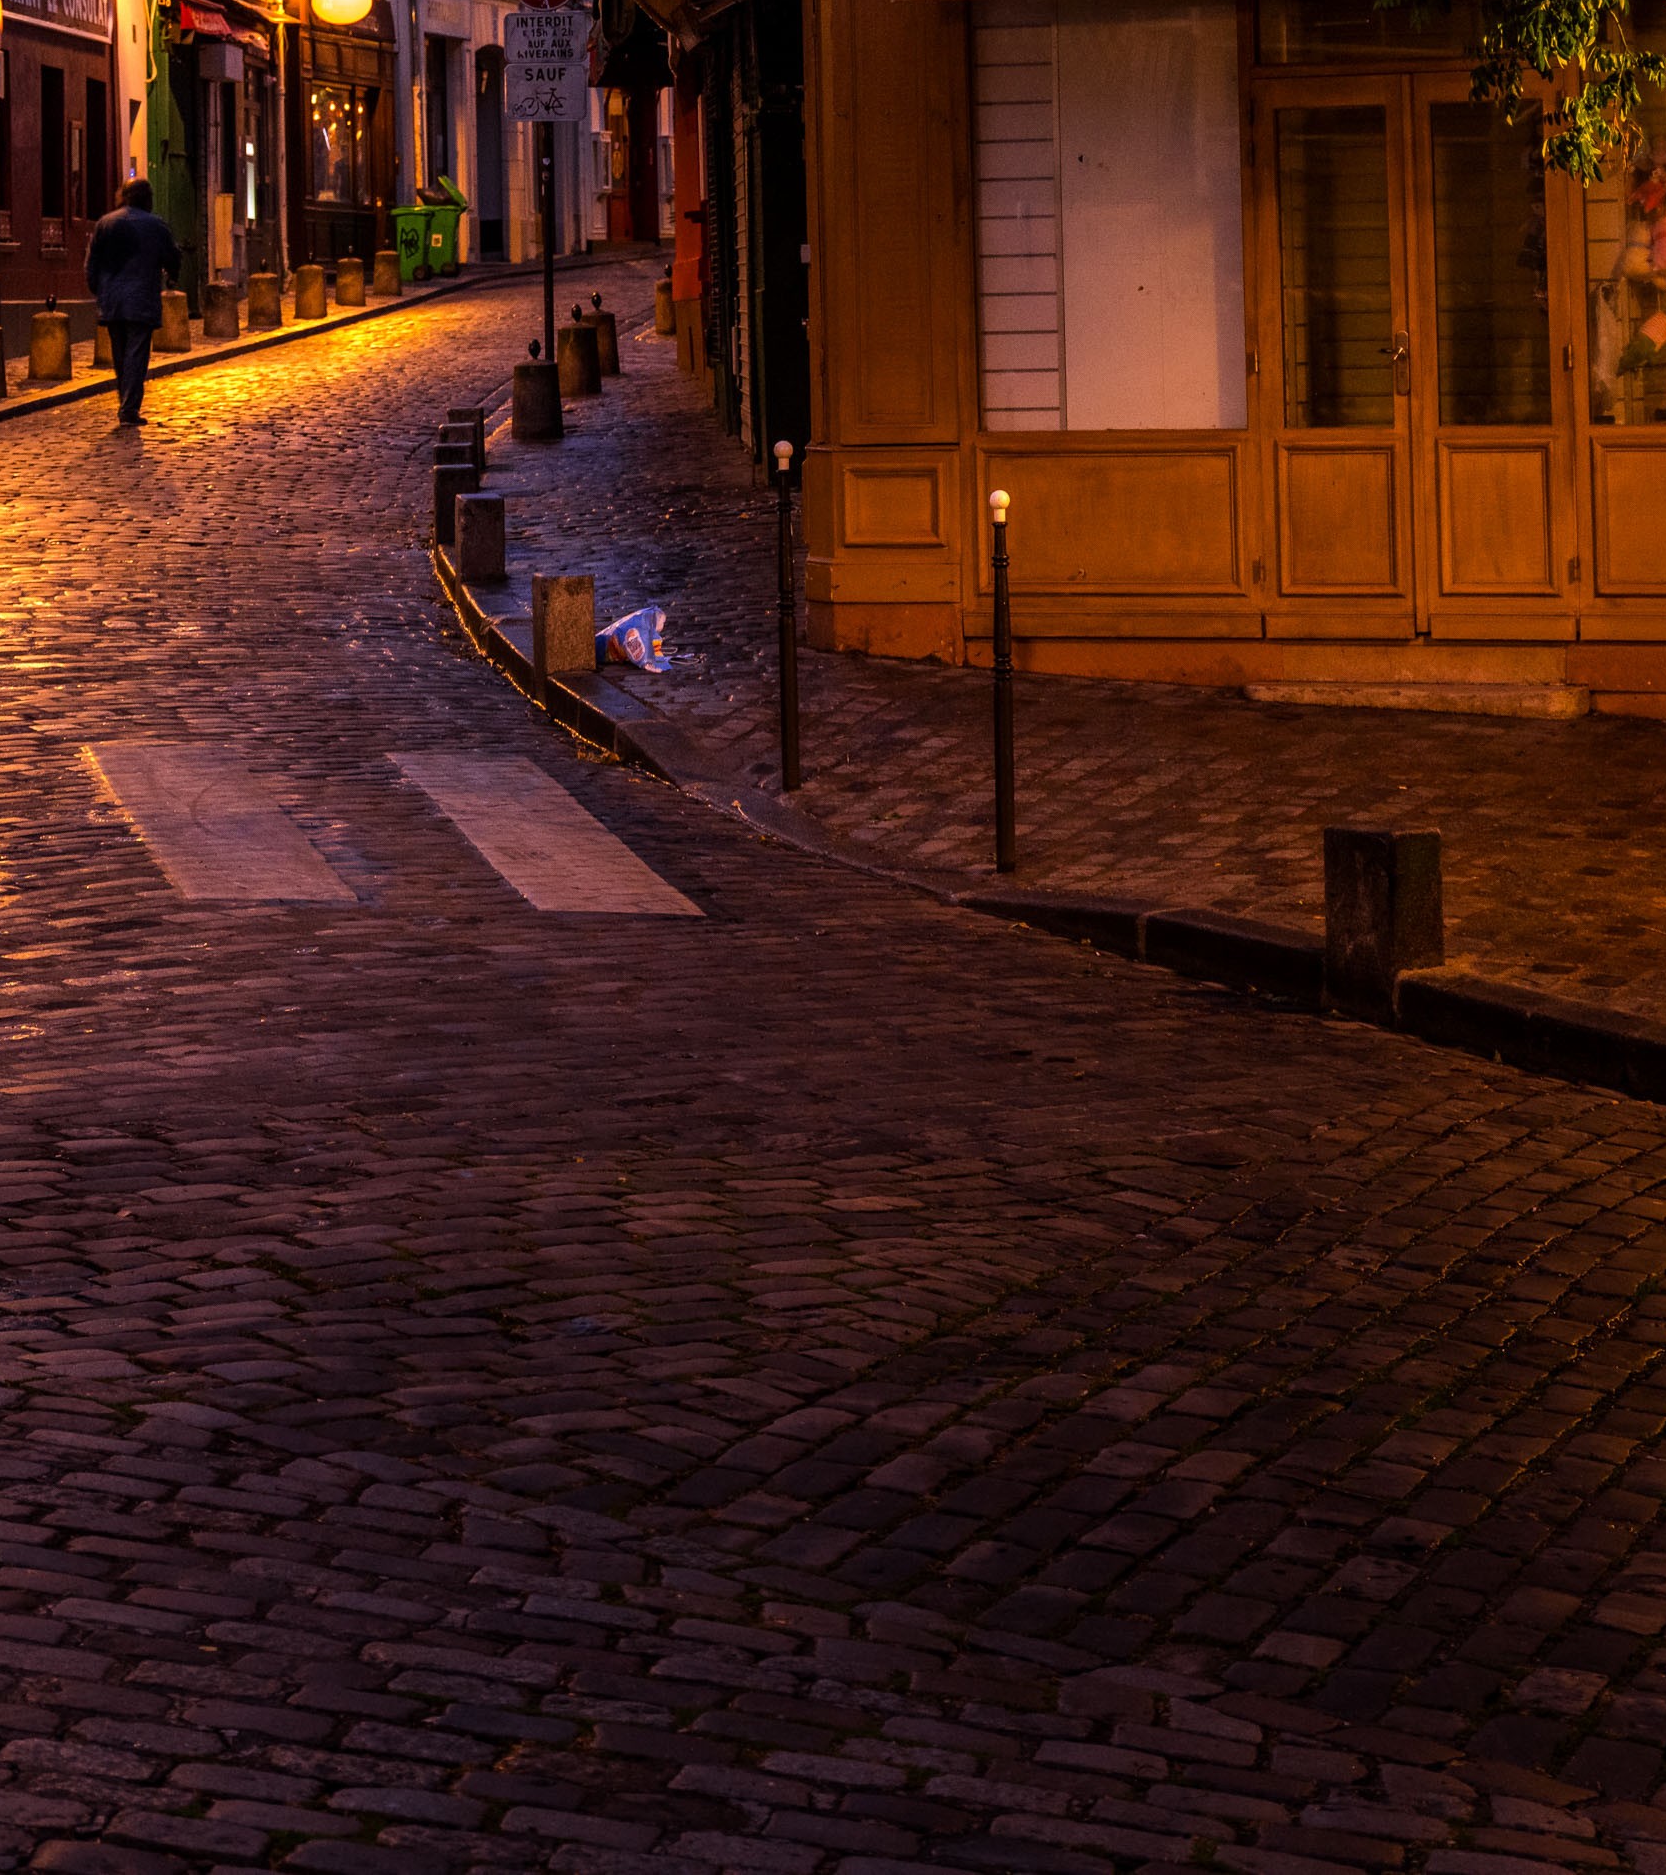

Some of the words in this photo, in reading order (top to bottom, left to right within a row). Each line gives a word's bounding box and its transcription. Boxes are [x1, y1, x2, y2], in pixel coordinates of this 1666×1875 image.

[516, 16, 574, 28] INTERDIT
[551, 39, 572, 48] AUX
[525, 68, 567, 81] SAUF
